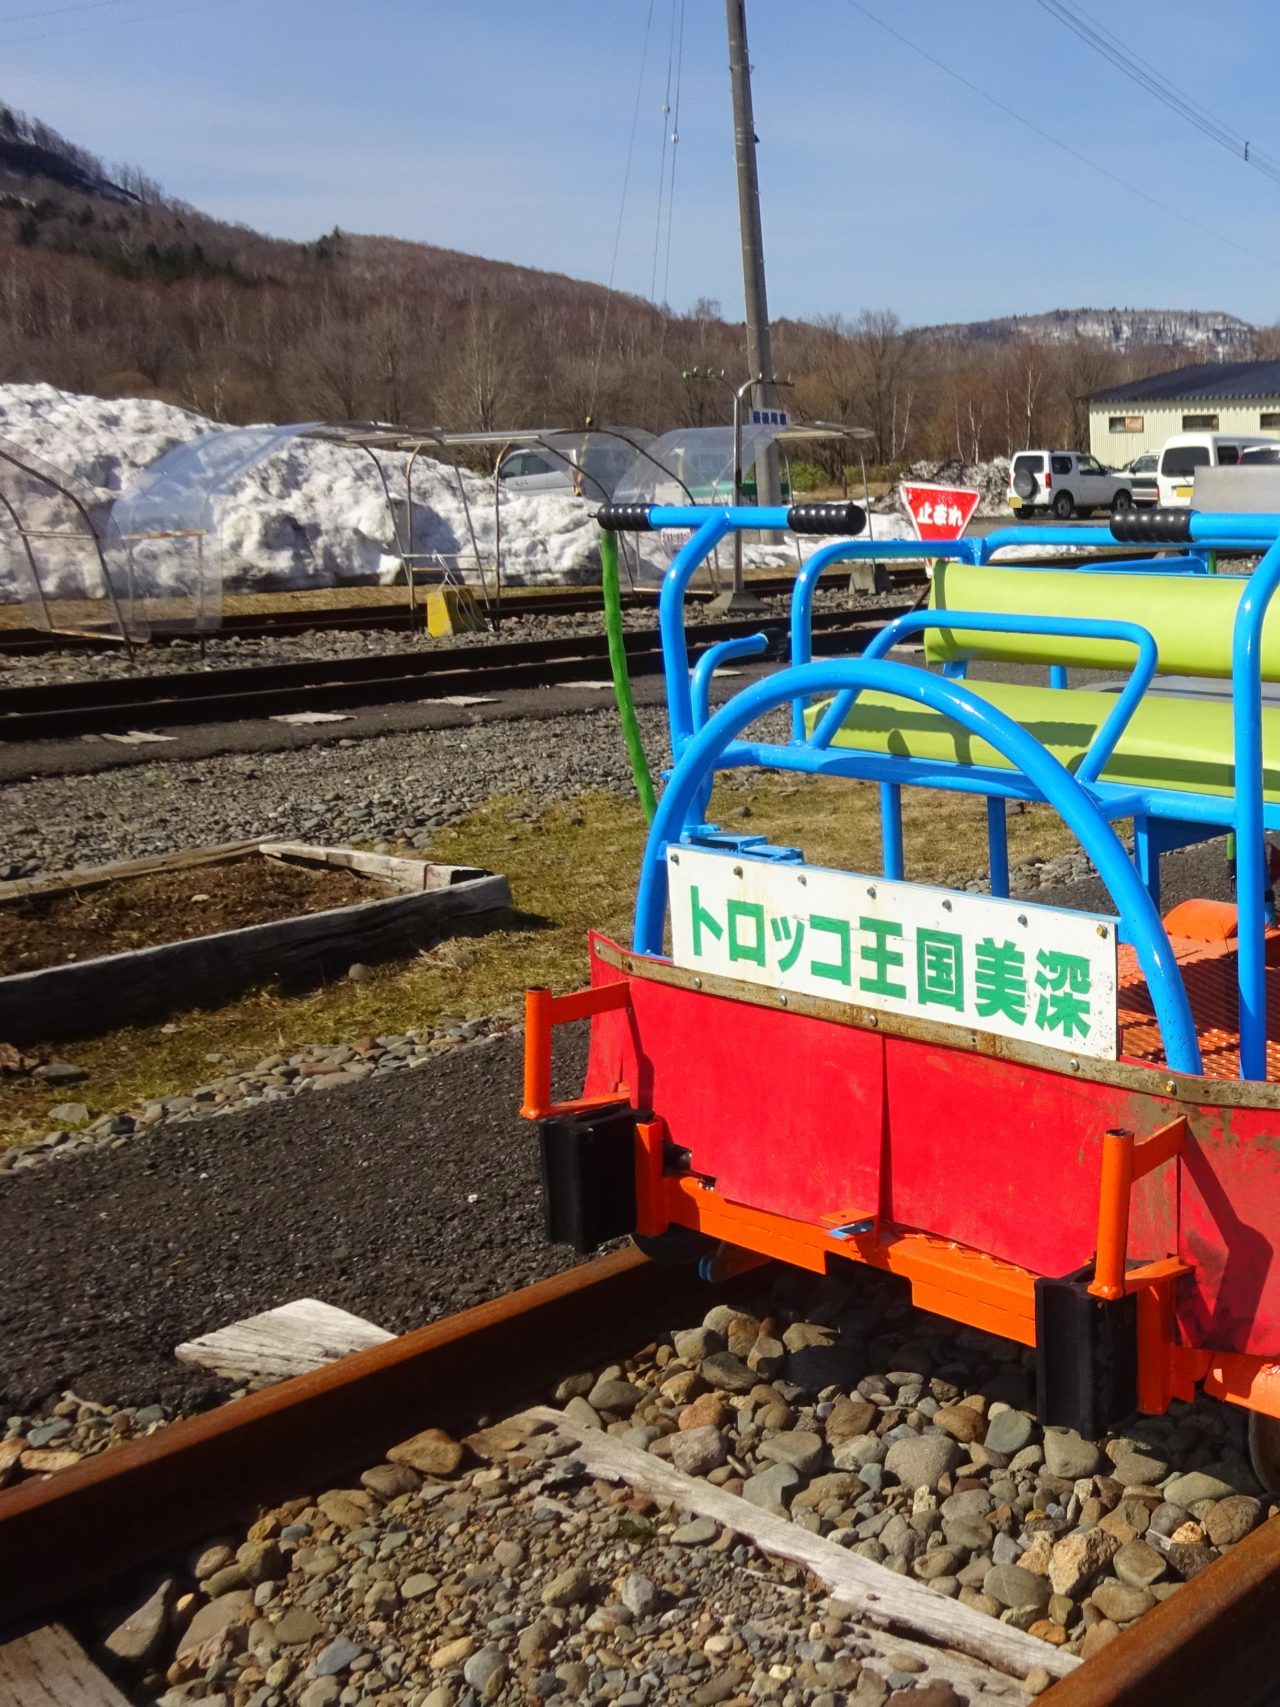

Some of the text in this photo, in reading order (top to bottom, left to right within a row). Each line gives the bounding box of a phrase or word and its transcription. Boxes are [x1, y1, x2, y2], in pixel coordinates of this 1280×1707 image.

[917, 502, 963, 527] 止まれ
[690, 885, 1092, 1038] トロッコ王国美深
